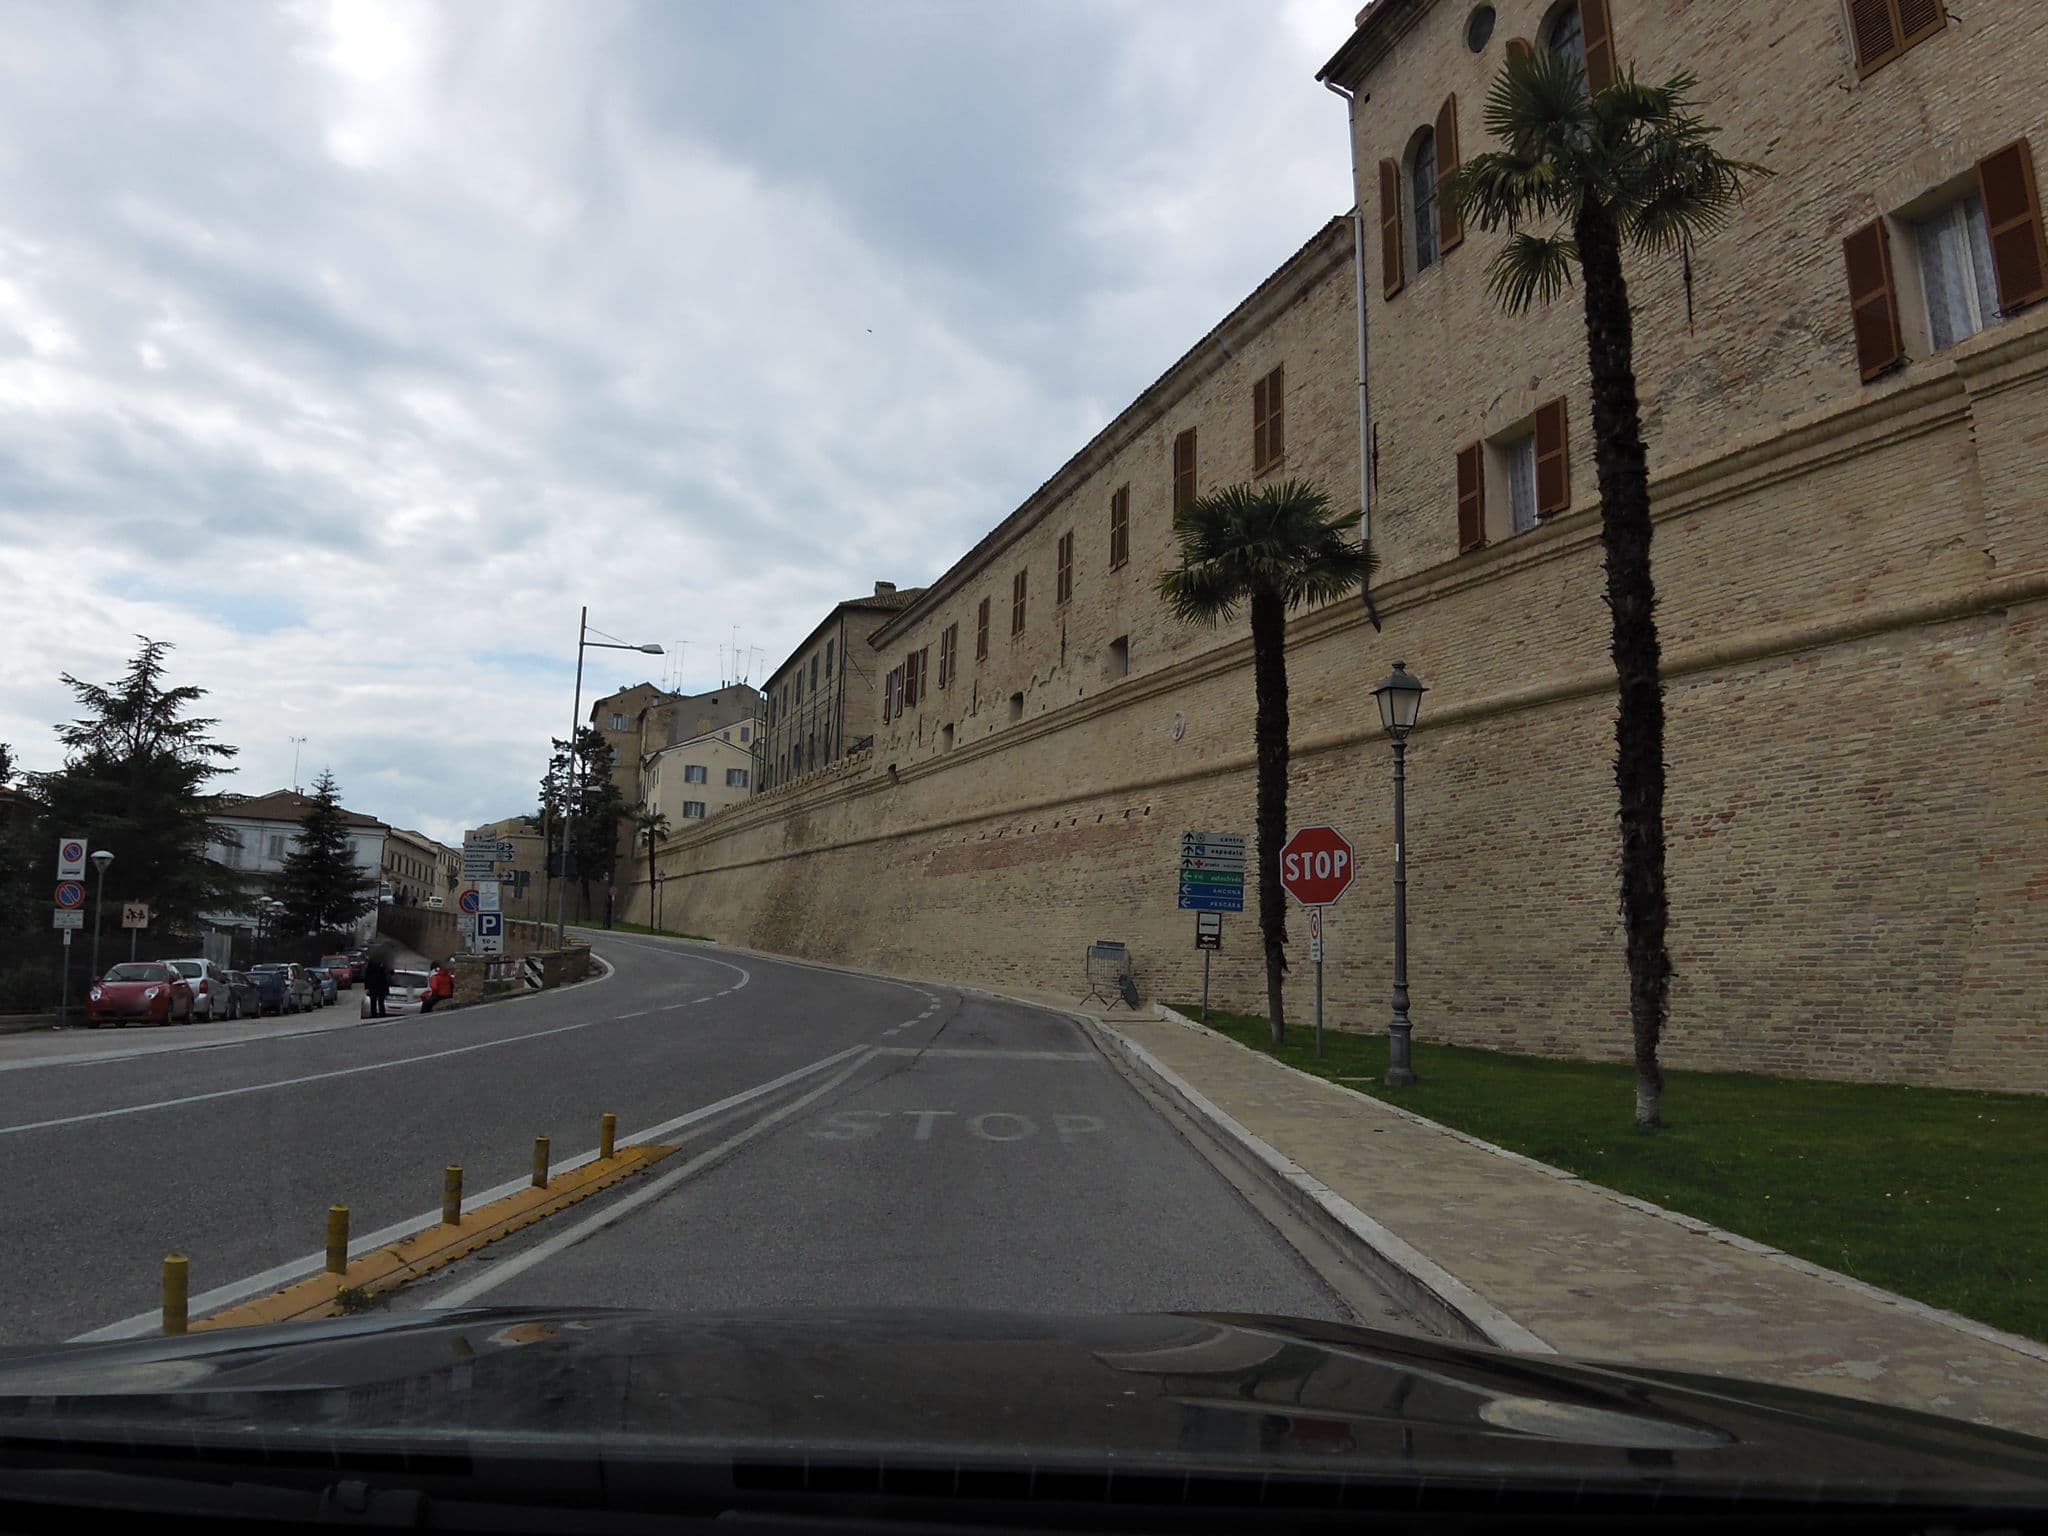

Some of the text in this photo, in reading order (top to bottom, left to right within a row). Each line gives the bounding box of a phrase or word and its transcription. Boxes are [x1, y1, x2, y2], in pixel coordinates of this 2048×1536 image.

[1285, 850, 1348, 881] STOP
[483, 916, 496, 934] P
[804, 1110, 1103, 1143] STOP
